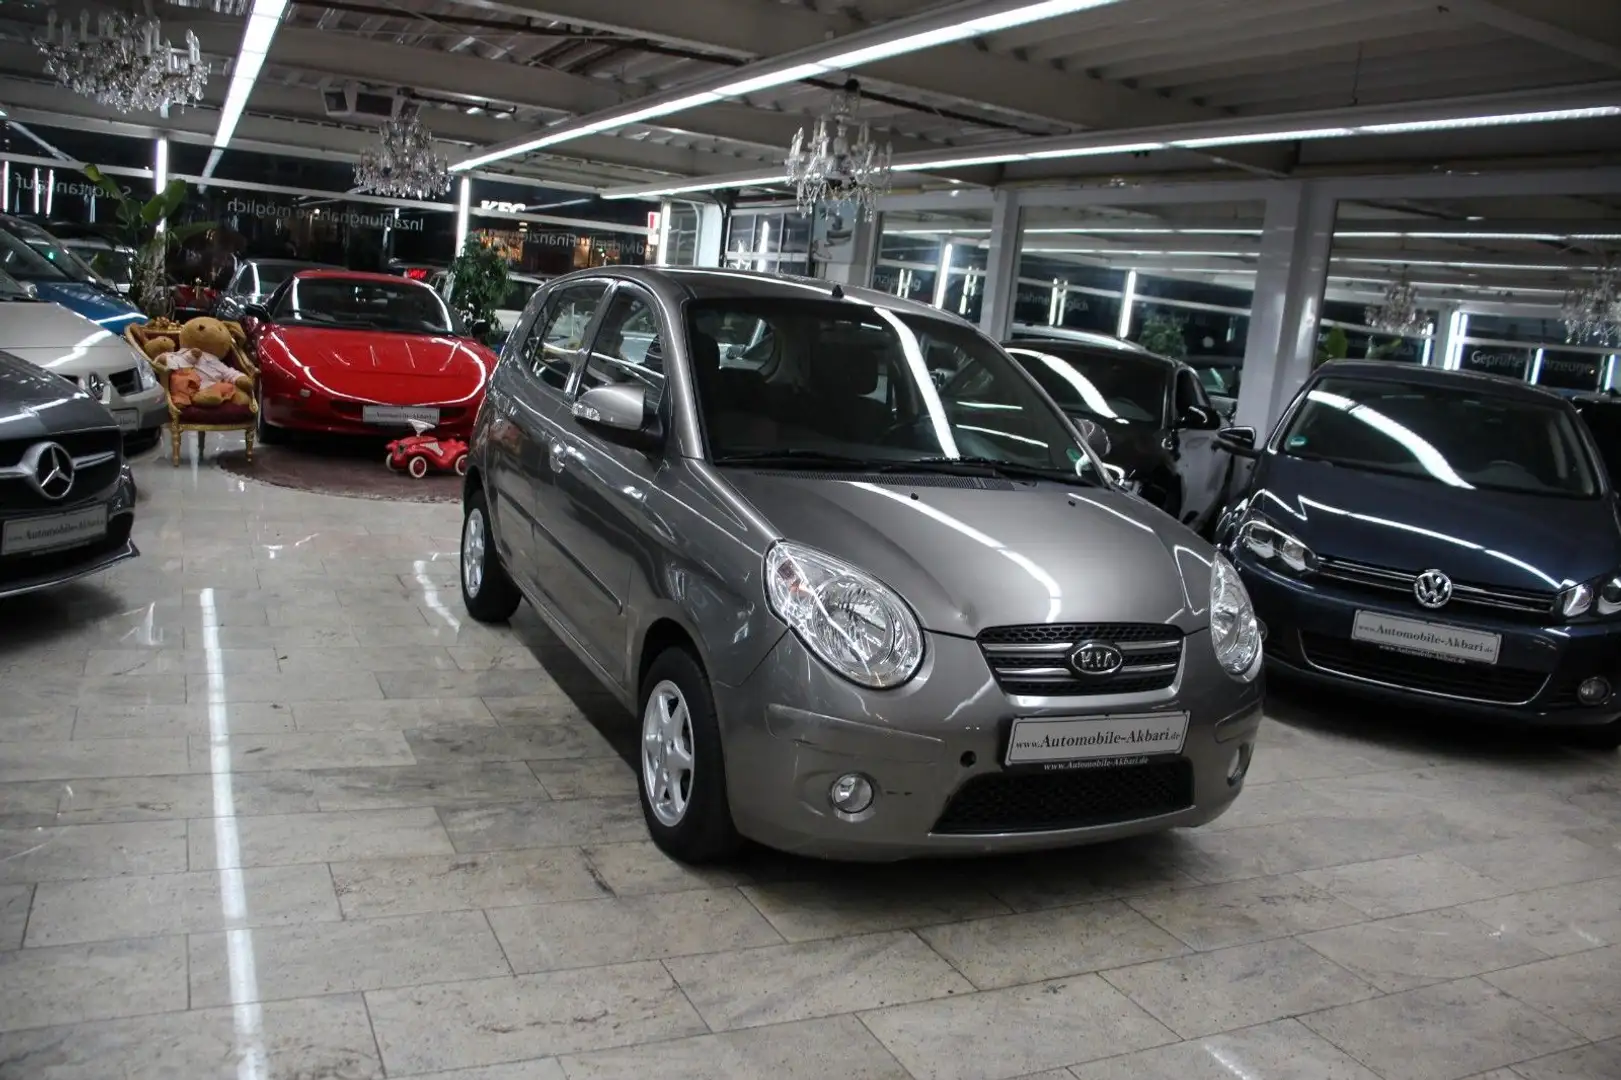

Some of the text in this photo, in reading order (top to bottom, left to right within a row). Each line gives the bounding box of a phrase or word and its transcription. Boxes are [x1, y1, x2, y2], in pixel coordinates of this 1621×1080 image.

[1358, 623, 1494, 654] www.Automobile-Akbari.de
[1080, 650, 1115, 668] KIA
[1016, 727, 1181, 750] www.Automobile-Akbari.de
[1043, 757, 1149, 771] www.Automobile-Akbari.de
